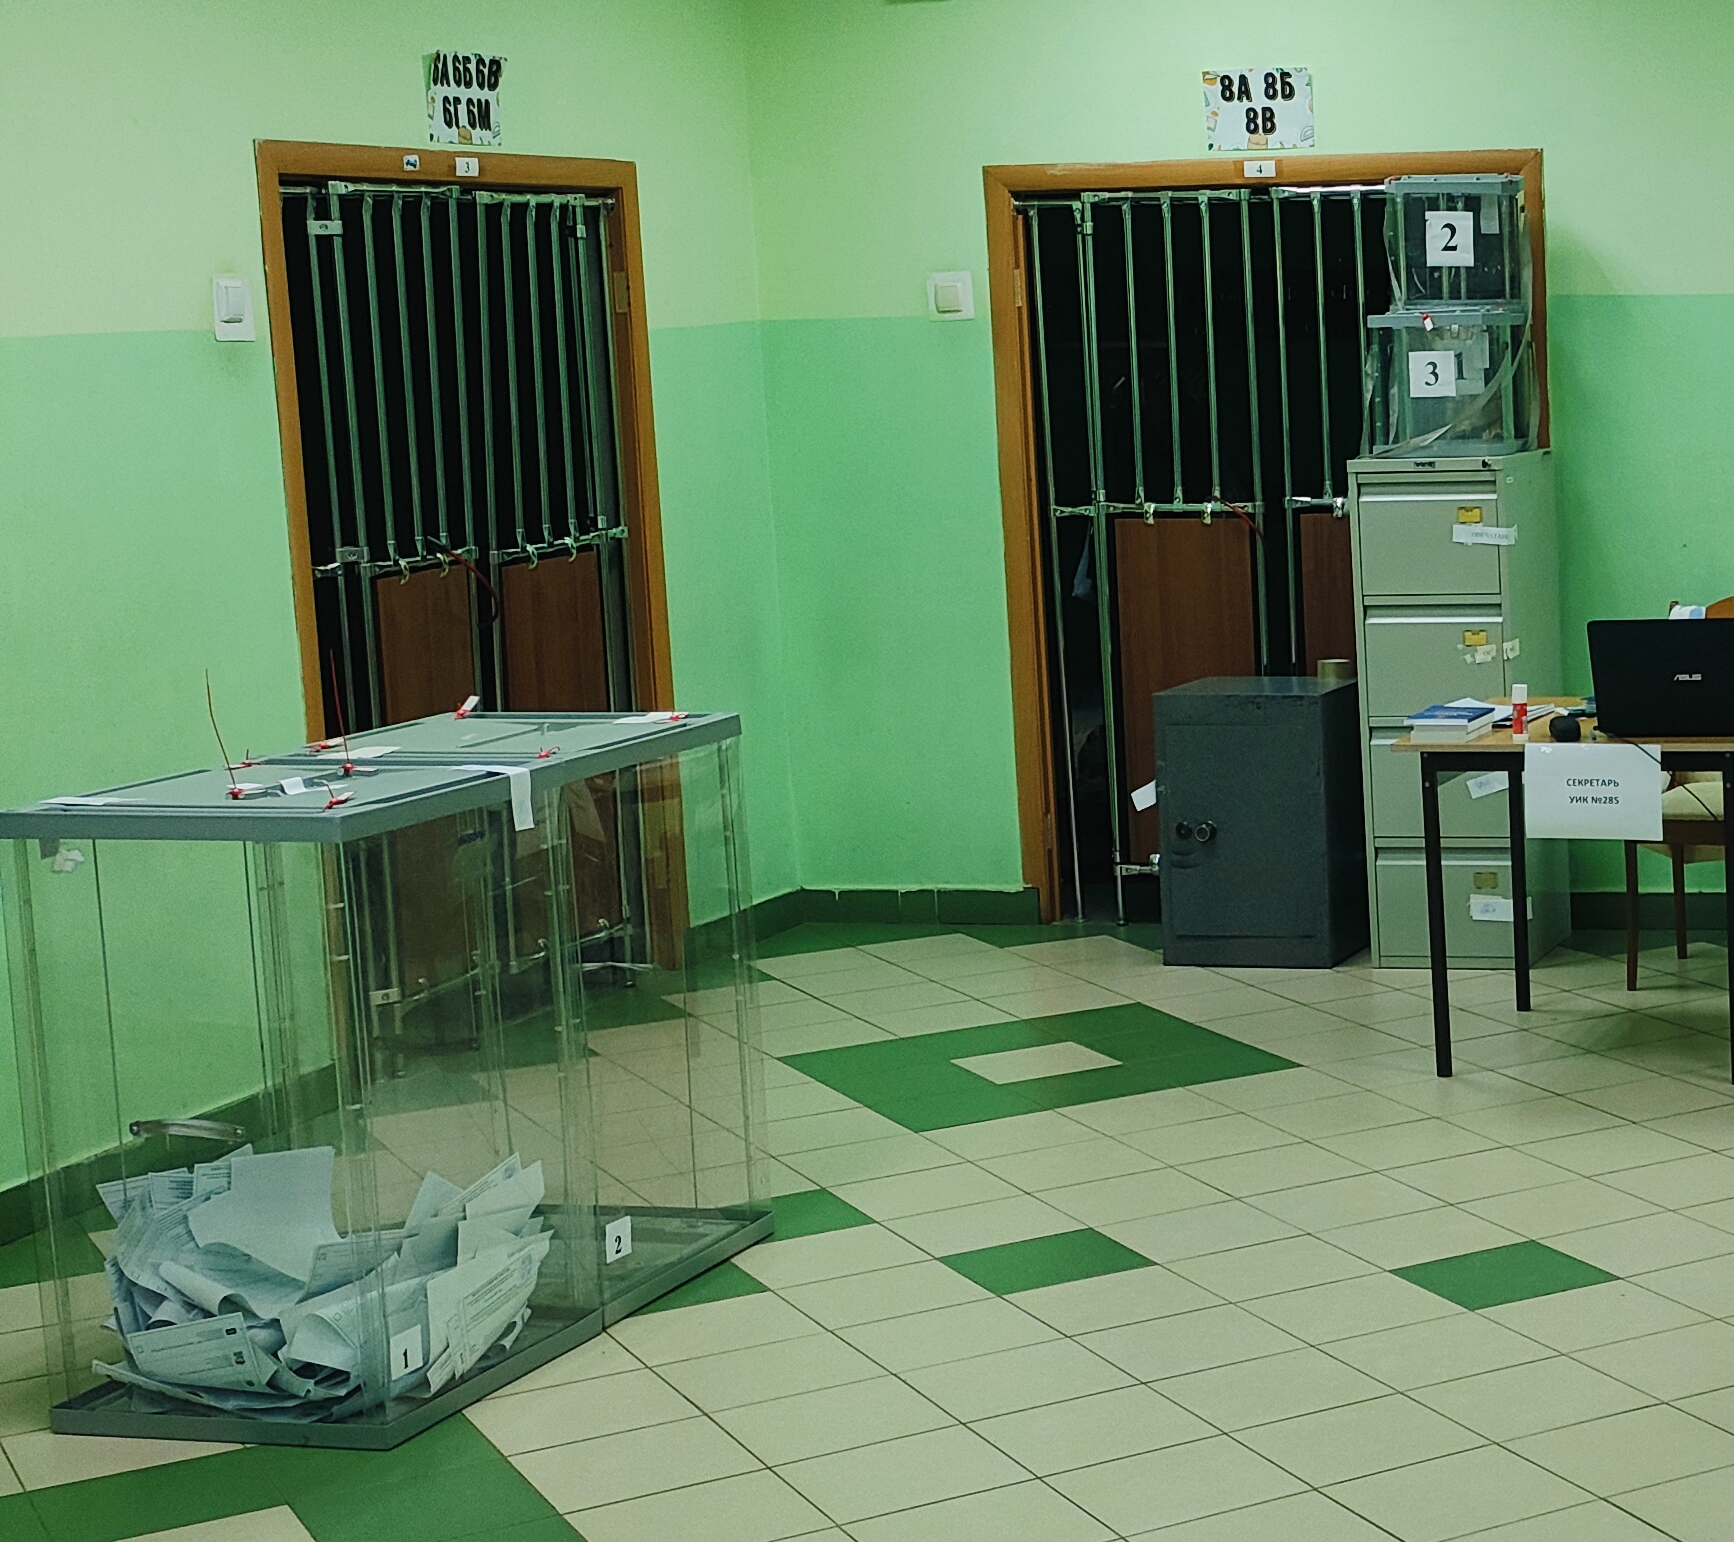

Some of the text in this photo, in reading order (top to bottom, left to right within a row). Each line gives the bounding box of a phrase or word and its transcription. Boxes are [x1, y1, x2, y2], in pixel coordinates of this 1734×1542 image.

[452, 53, 473, 90] 6Б
[475, 57, 502, 91] 6В
[1220, 71, 1296, 102] 8А 8Б
[442, 95, 492, 131] 6Г 6М
[1245, 107, 1277, 135] 8В
[464, 161, 470, 174] 3
[1256, 164, 1263, 174] 4
[1440, 222, 1459, 252] 2
[1423, 361, 1440, 387] 3
[1454, 351, 1467, 381] 1
[1673, 673, 1702, 681] ASUS
[1566, 778, 1620, 788] СЕКРЕТАРЬ
[1568, 795, 1620, 805] УИК №285
[614, 1234, 623, 1255] 2
[402, 1348, 409, 1370] 1
